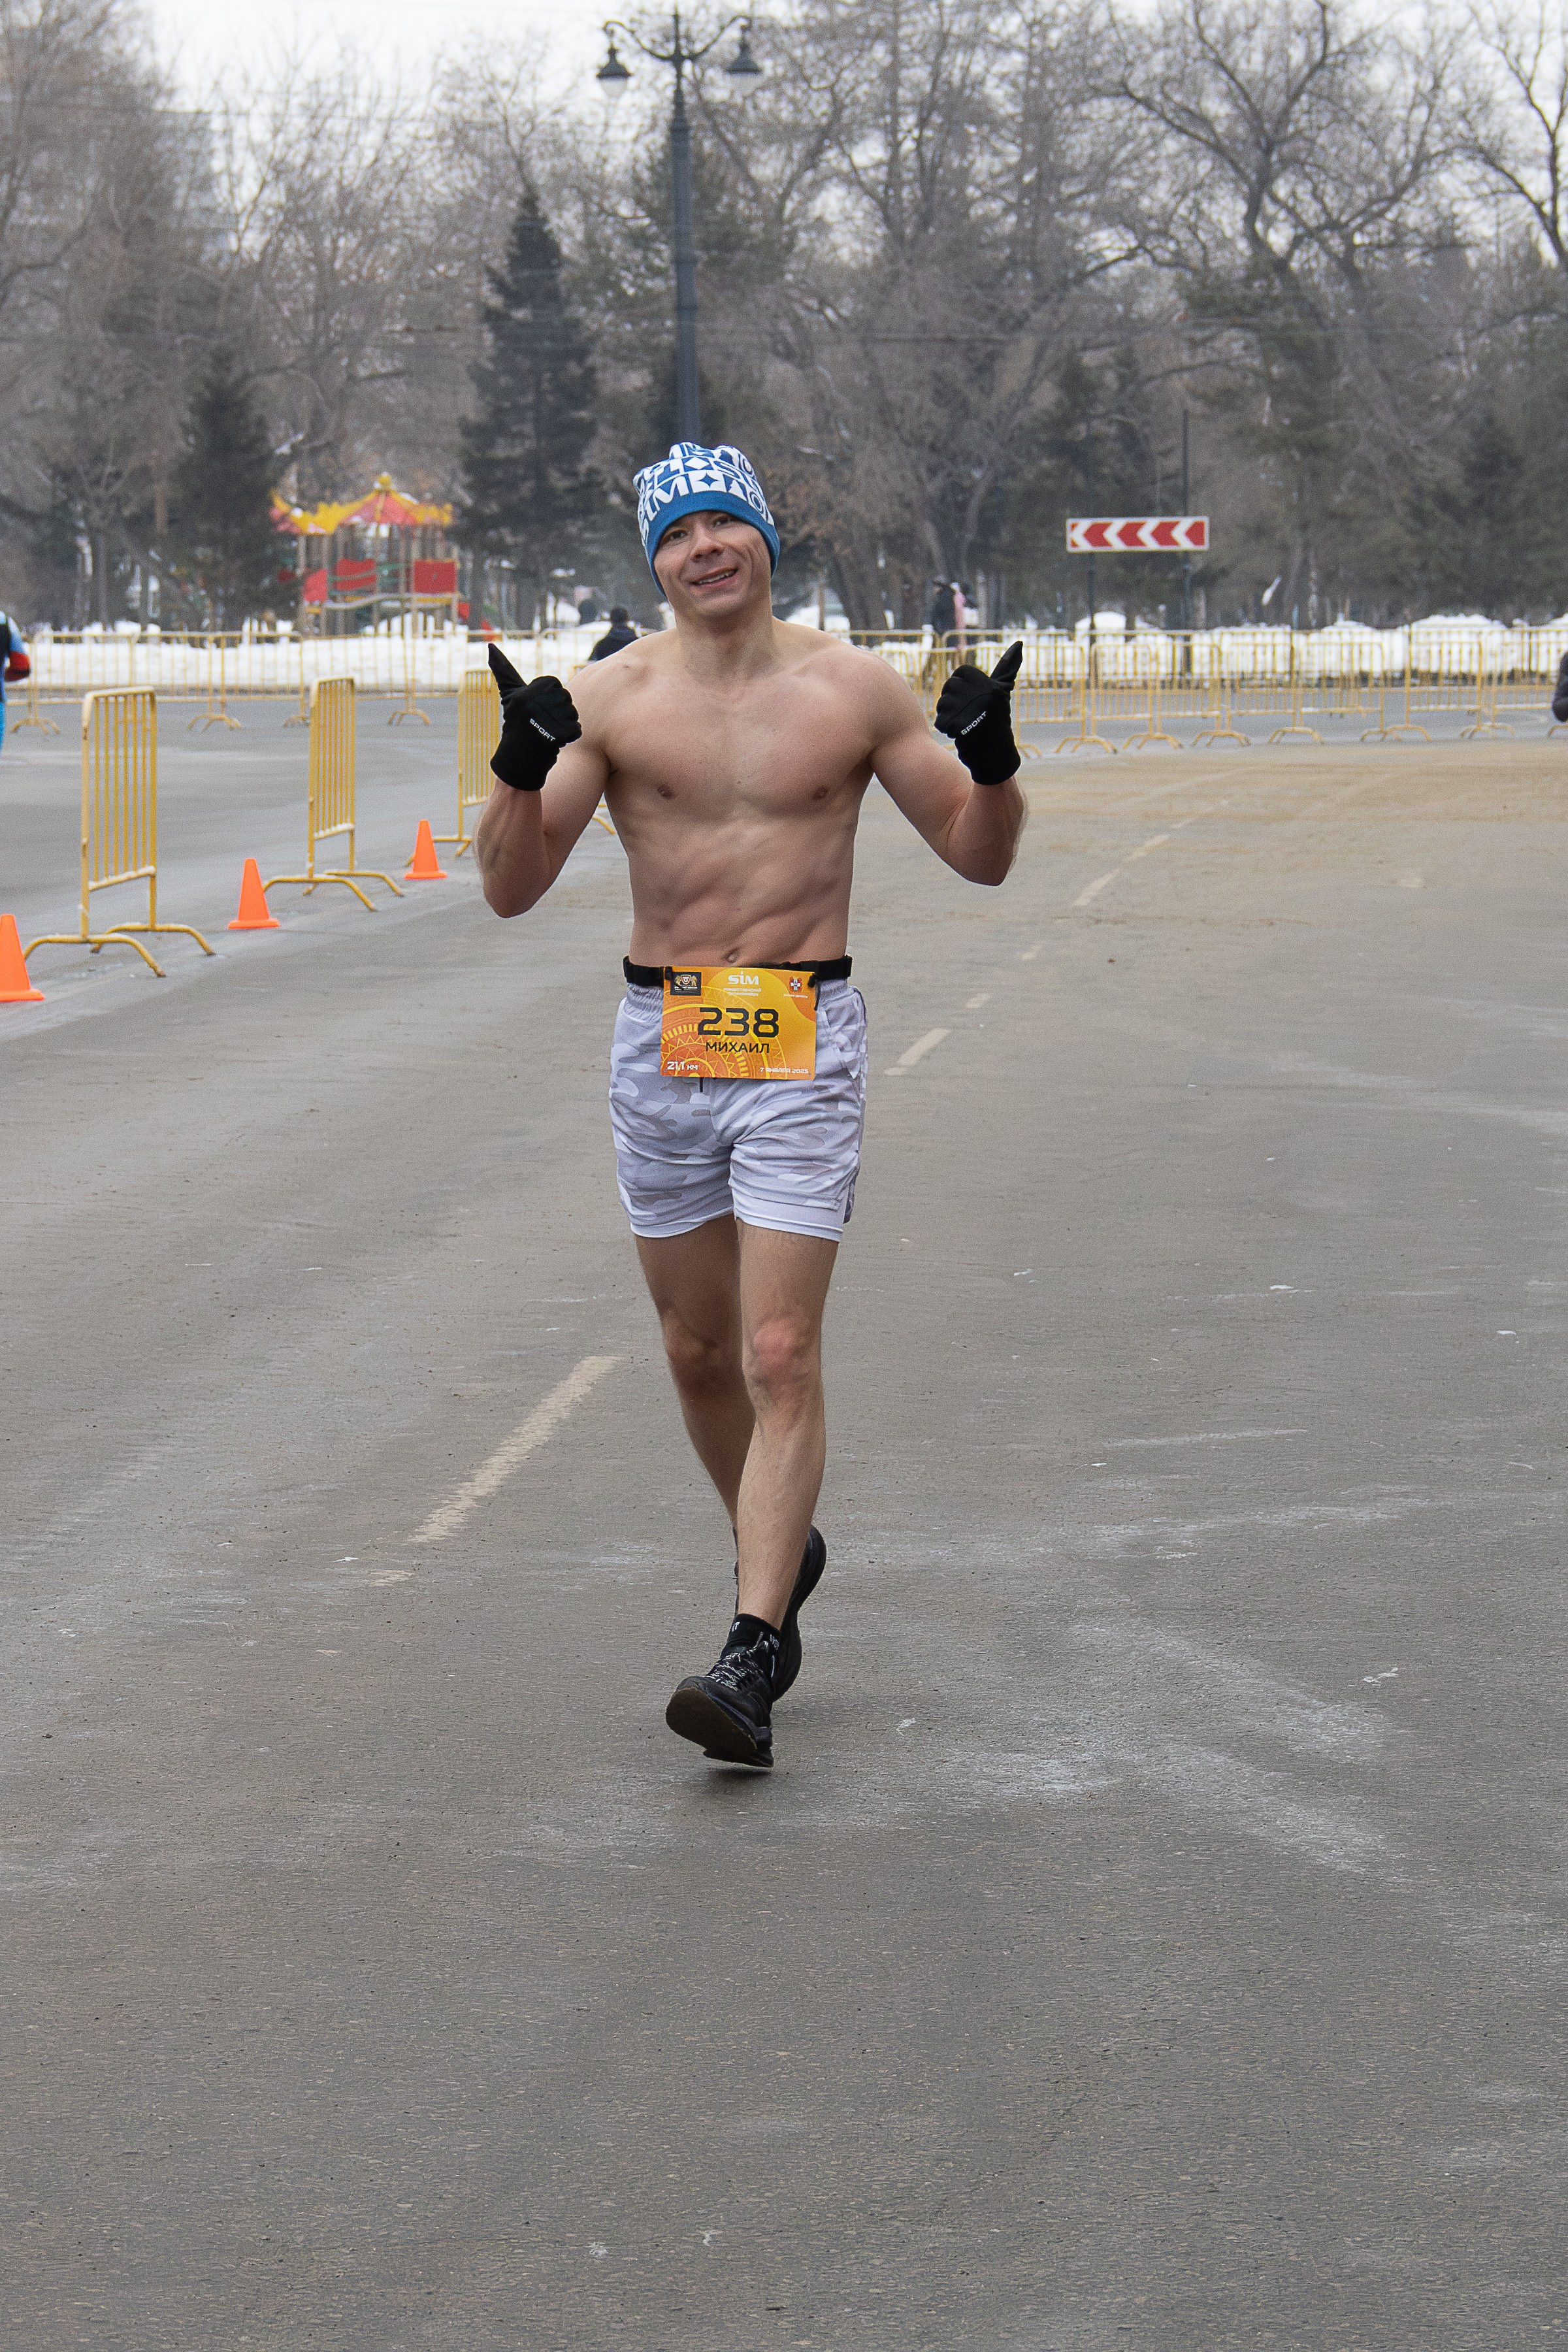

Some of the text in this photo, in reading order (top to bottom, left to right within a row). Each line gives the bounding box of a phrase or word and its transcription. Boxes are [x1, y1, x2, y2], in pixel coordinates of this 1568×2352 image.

[530, 719, 555, 742] SPORT
[961, 711, 987, 735] SPORT
[698, 1007, 779, 1037] 238
[706, 1041, 770, 1053] МИХАИЛ
[667, 1061, 685, 1071] 21,1
